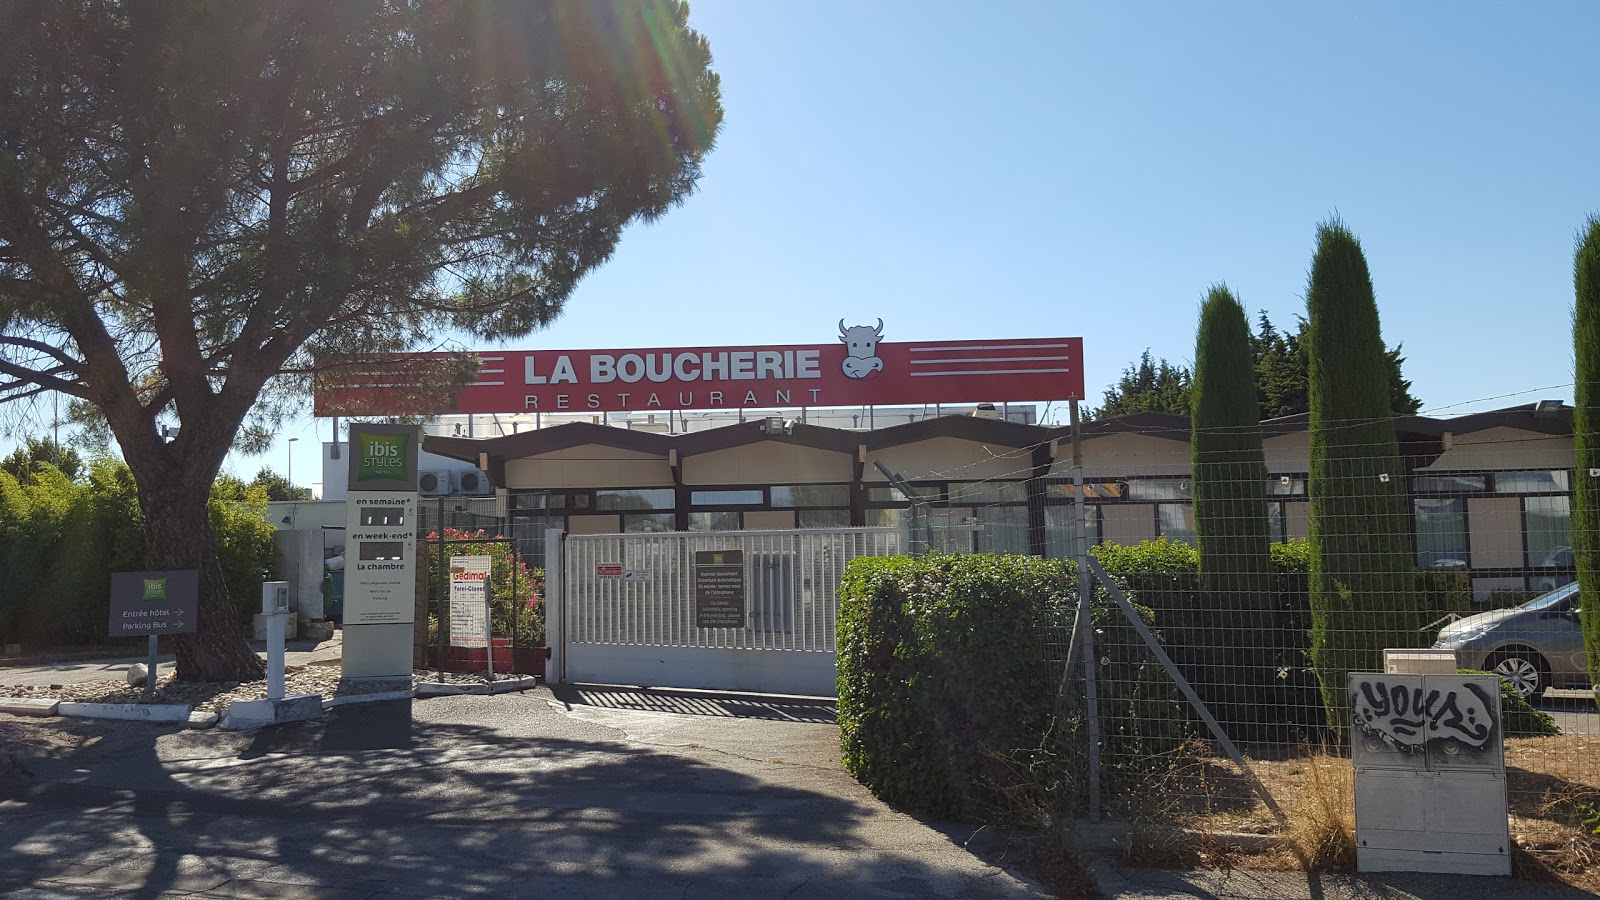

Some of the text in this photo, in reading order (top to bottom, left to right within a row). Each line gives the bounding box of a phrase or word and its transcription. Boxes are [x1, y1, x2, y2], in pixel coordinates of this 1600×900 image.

[525, 350, 822, 385] LA BOUCHERIE
[525, 388, 821, 409] RESTAURANT
[369, 441, 398, 457] ibis
[123, 608, 170, 618] Entrée hôtel
[122, 621, 167, 630] Parking Bus
